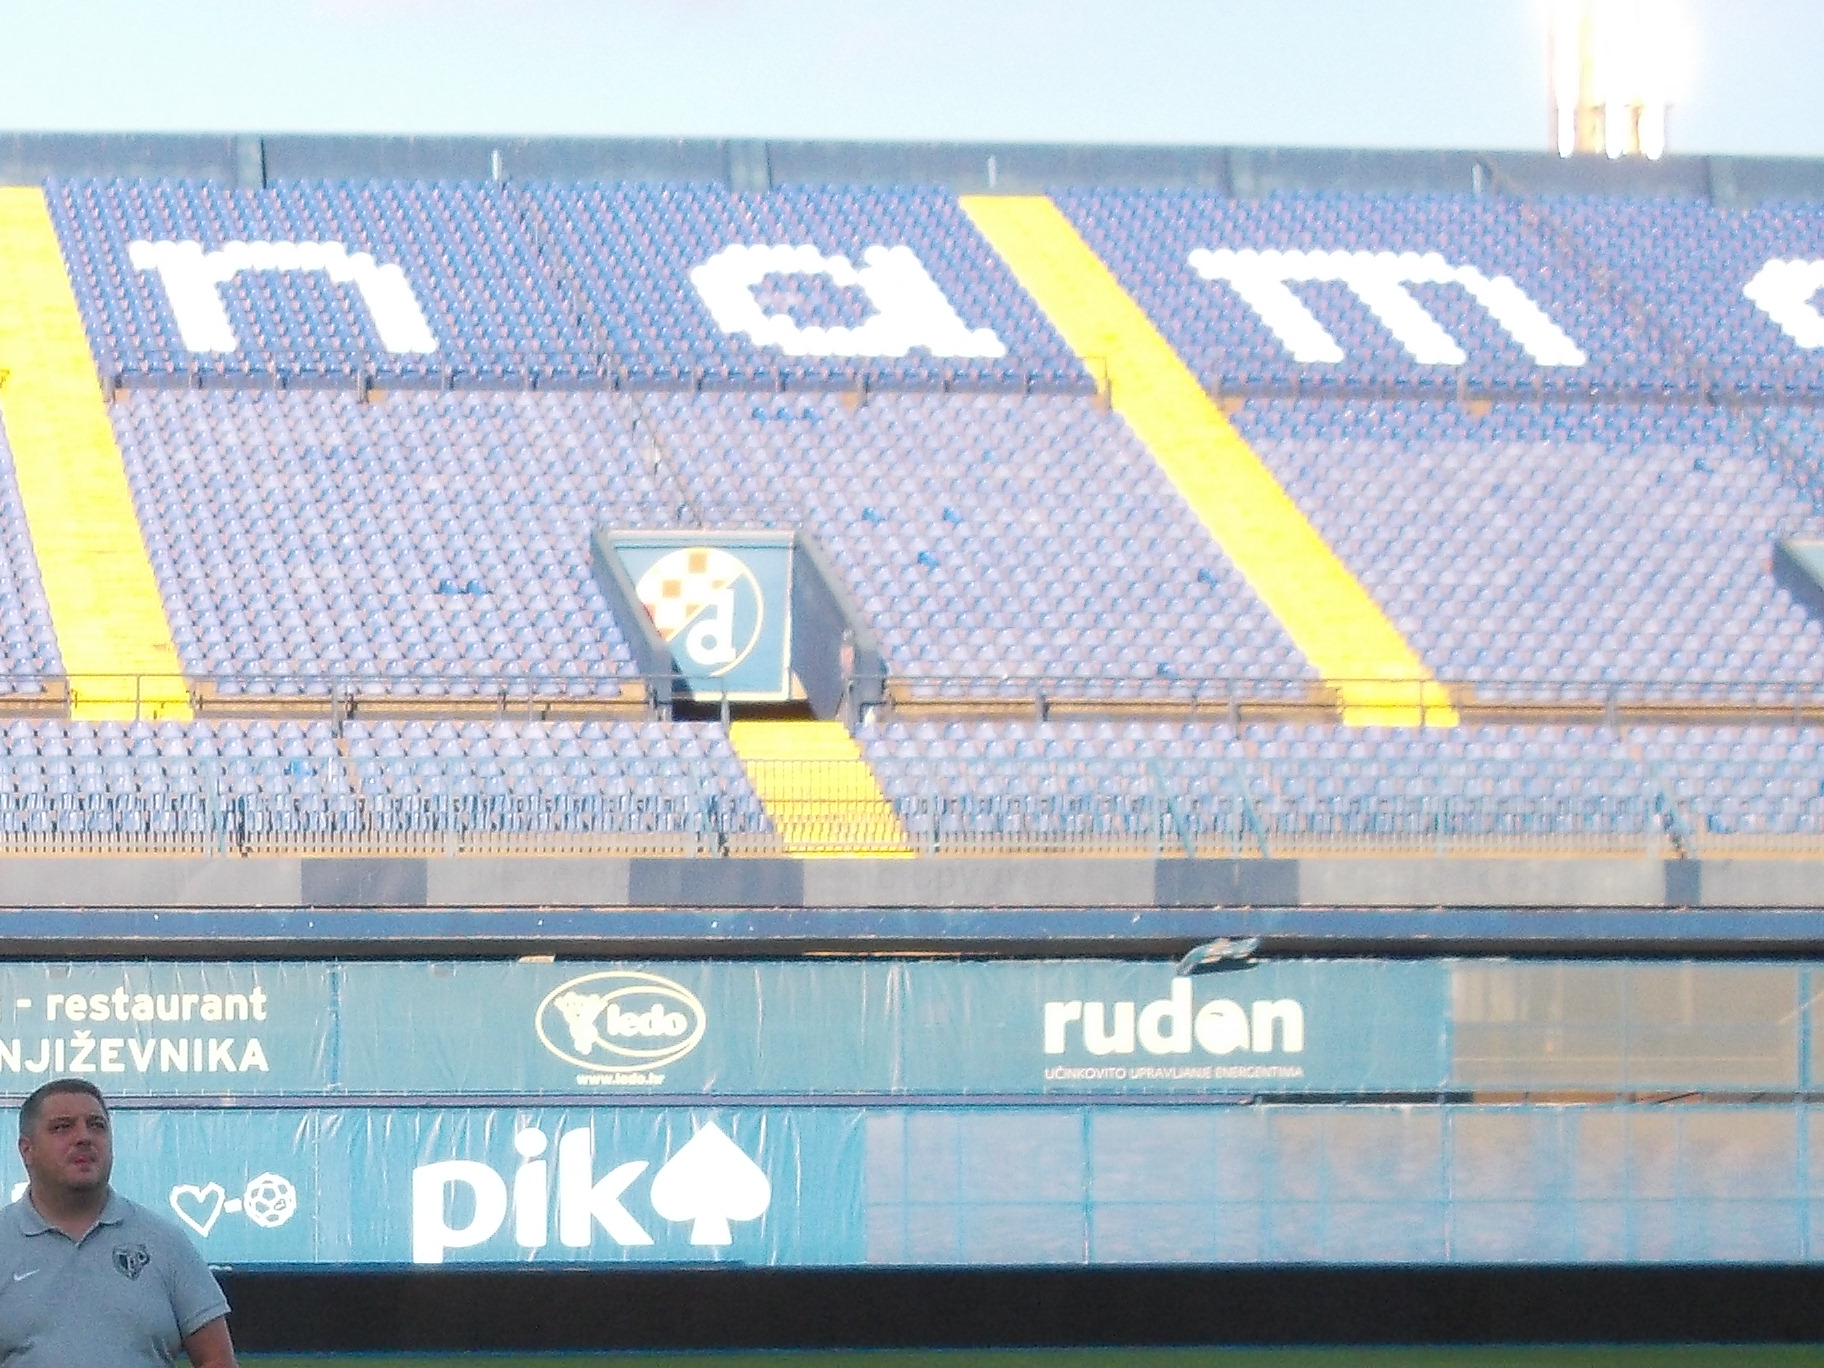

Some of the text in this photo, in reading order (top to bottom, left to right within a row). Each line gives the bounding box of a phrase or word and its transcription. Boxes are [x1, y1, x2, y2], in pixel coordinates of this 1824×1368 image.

[47, 987, 267, 1021] restaurant
[606, 1003, 688, 1037] ledo
[412, 1127, 655, 1264] pik
